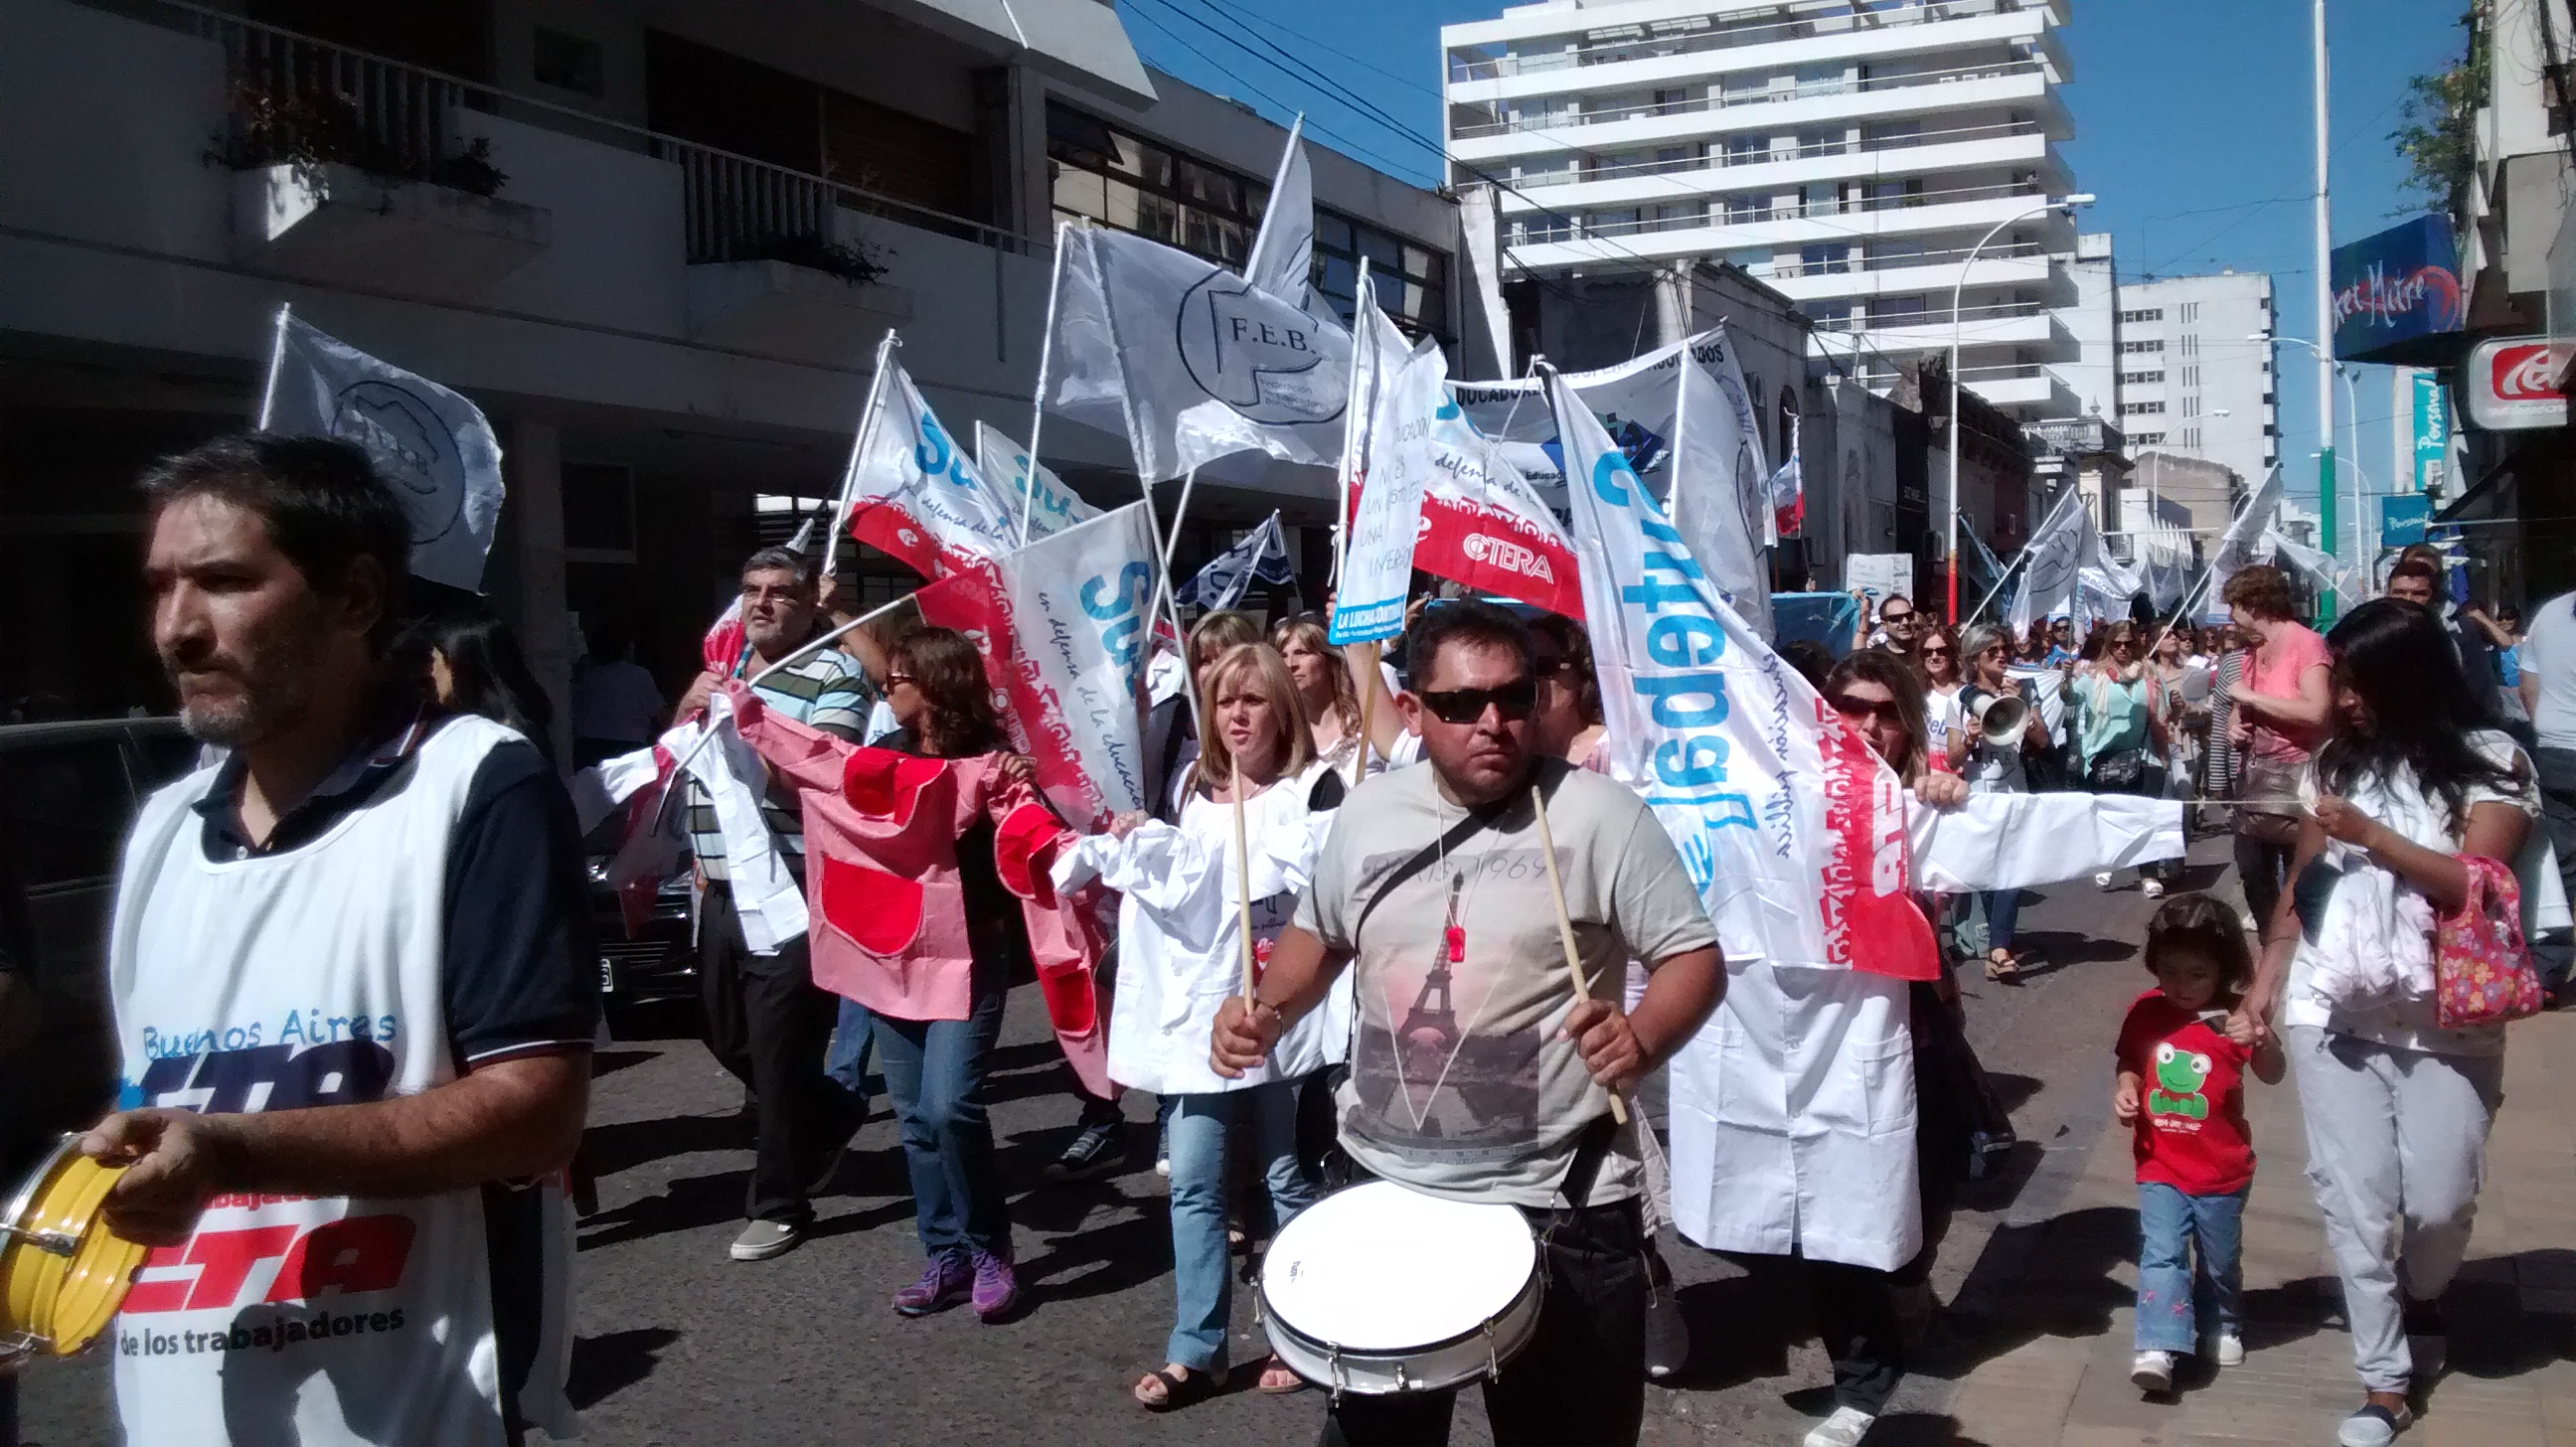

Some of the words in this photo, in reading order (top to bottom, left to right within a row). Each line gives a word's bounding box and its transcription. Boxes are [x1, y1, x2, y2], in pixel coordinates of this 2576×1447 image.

[1229, 316, 1317, 355] F.E.B.
[2416, 379, 2444, 450] Personal
[2387, 510, 2431, 531] Personal
[1463, 533, 1554, 584] CTERA
[1337, 612, 1350, 629] LA
[1076, 686, 1096, 706] de
[1088, 709, 1110, 728] la
[142, 1021, 262, 1061] Buenos
[279, 1008, 397, 1046] Aires
[120, 1329, 139, 1357] de
[144, 1327, 180, 1356] los
[184, 1307, 405, 1353] trabajadores
